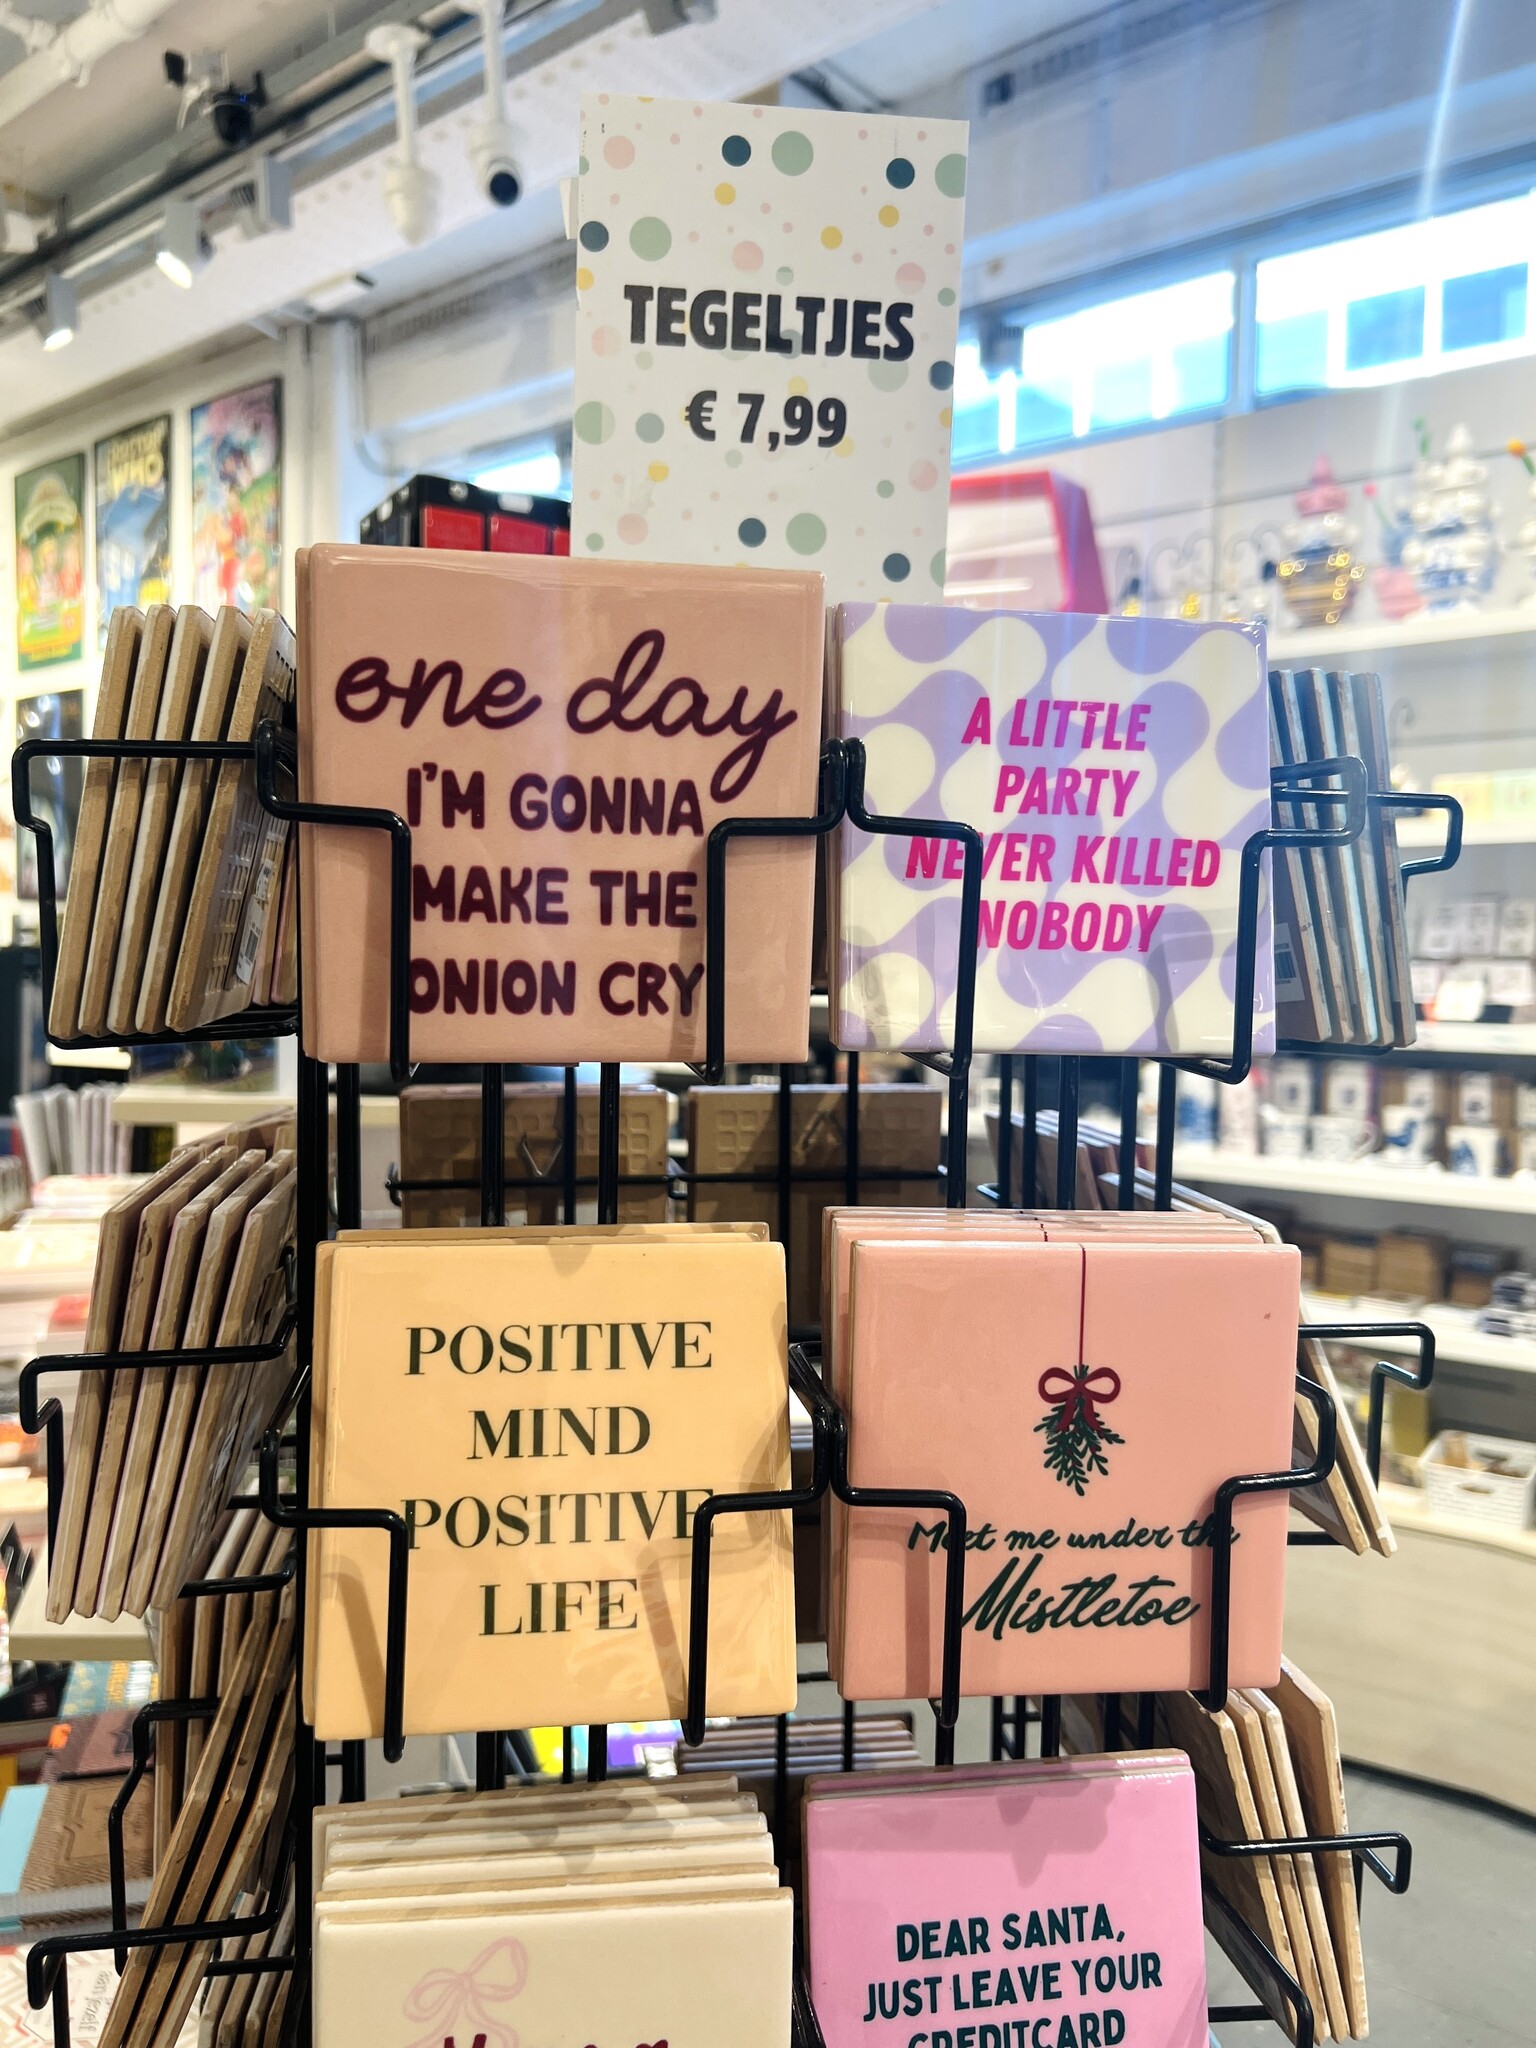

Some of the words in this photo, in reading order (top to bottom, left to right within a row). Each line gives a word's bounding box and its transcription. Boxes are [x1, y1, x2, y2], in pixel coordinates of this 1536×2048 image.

[624, 284, 914, 361] TEGELTJES
[685, 390, 717, 442] €
[738, 393, 847, 452] 7,99
[335, 657, 542, 729] one
[566, 629, 798, 803] day
[961, 697, 991, 745] A
[1008, 699, 1152, 752] LITTLE
[510, 773, 705, 837] GONNA
[993, 765, 1140, 817] PARTY
[1070, 836, 1221, 888] KILLED
[412, 864, 569, 925] MAKE
[590, 870, 698, 928] THE
[977, 900, 1165, 953] NOBODY
[410, 957, 576, 1016] ONION
[599, 961, 705, 1017] CRY
[404, 1321, 712, 1376] POSITIVE
[466, 1406, 651, 1460] MIND
[401, 1488, 714, 1550] POSITIVE
[1004, 1525, 1061, 1552] me
[1067, 1518, 1174, 1550] under
[479, 1578, 638, 1636] LIFE
[961, 1553, 1201, 1641] Mistletoe
[896, 1917, 990, 1962] DEAR
[1002, 1903, 1126, 1951] SANTA,
[863, 1976, 943, 2022] JUST
[953, 1961, 1063, 2011] LEAVE
[1072, 1952, 1163, 1996] YOUR
